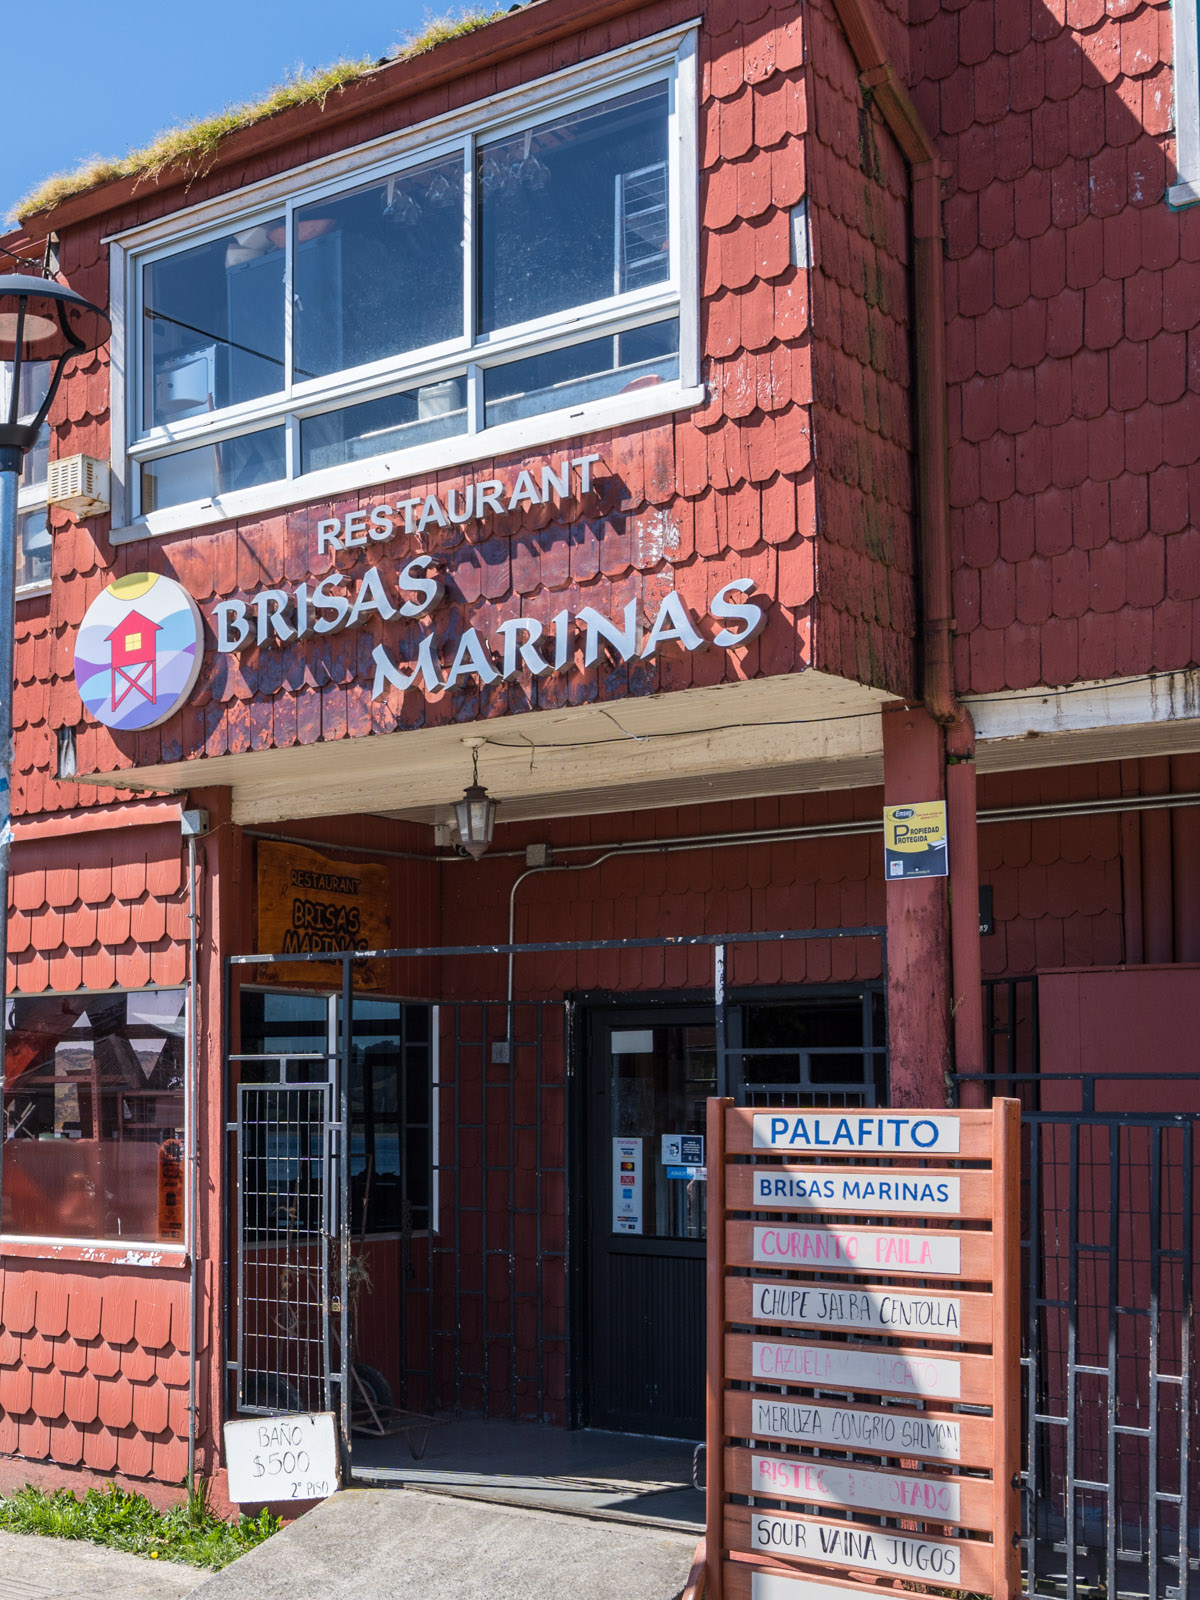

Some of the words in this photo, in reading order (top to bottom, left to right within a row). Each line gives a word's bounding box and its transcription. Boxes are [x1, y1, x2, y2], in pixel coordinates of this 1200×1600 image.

[317, 453, 600, 555] RESTAURANT
[211, 555, 443, 653] BRISAS
[371, 577, 767, 702] MARINAS
[290, 869, 362, 895] RESTAURANT
[293, 898, 361, 936] BRISAS
[770, 1117, 940, 1148] PALAFITO
[759, 1179, 835, 1198] BRISAS
[842, 1181, 949, 1203] MARINAS
[761, 1230, 859, 1260] CURANTO
[875, 1236, 933, 1265] PAILA
[760, 1288, 808, 1318] CHUPE
[879, 1296, 958, 1329] CENTOLLA
[759, 1346, 832, 1377] CAZUELA
[258, 1422, 303, 1447] BAÑO
[758, 1404, 822, 1434] MERLUZA
[832, 1411, 896, 1445] CONGRIO
[252, 1450, 311, 1478] $500
[759, 1460, 830, 1493] BISTEC
[306, 1481, 329, 1496] PISO
[757, 1519, 807, 1548] SOUR
[819, 1527, 877, 1561] VAINA
[885, 1538, 956, 1575] JUGOS
